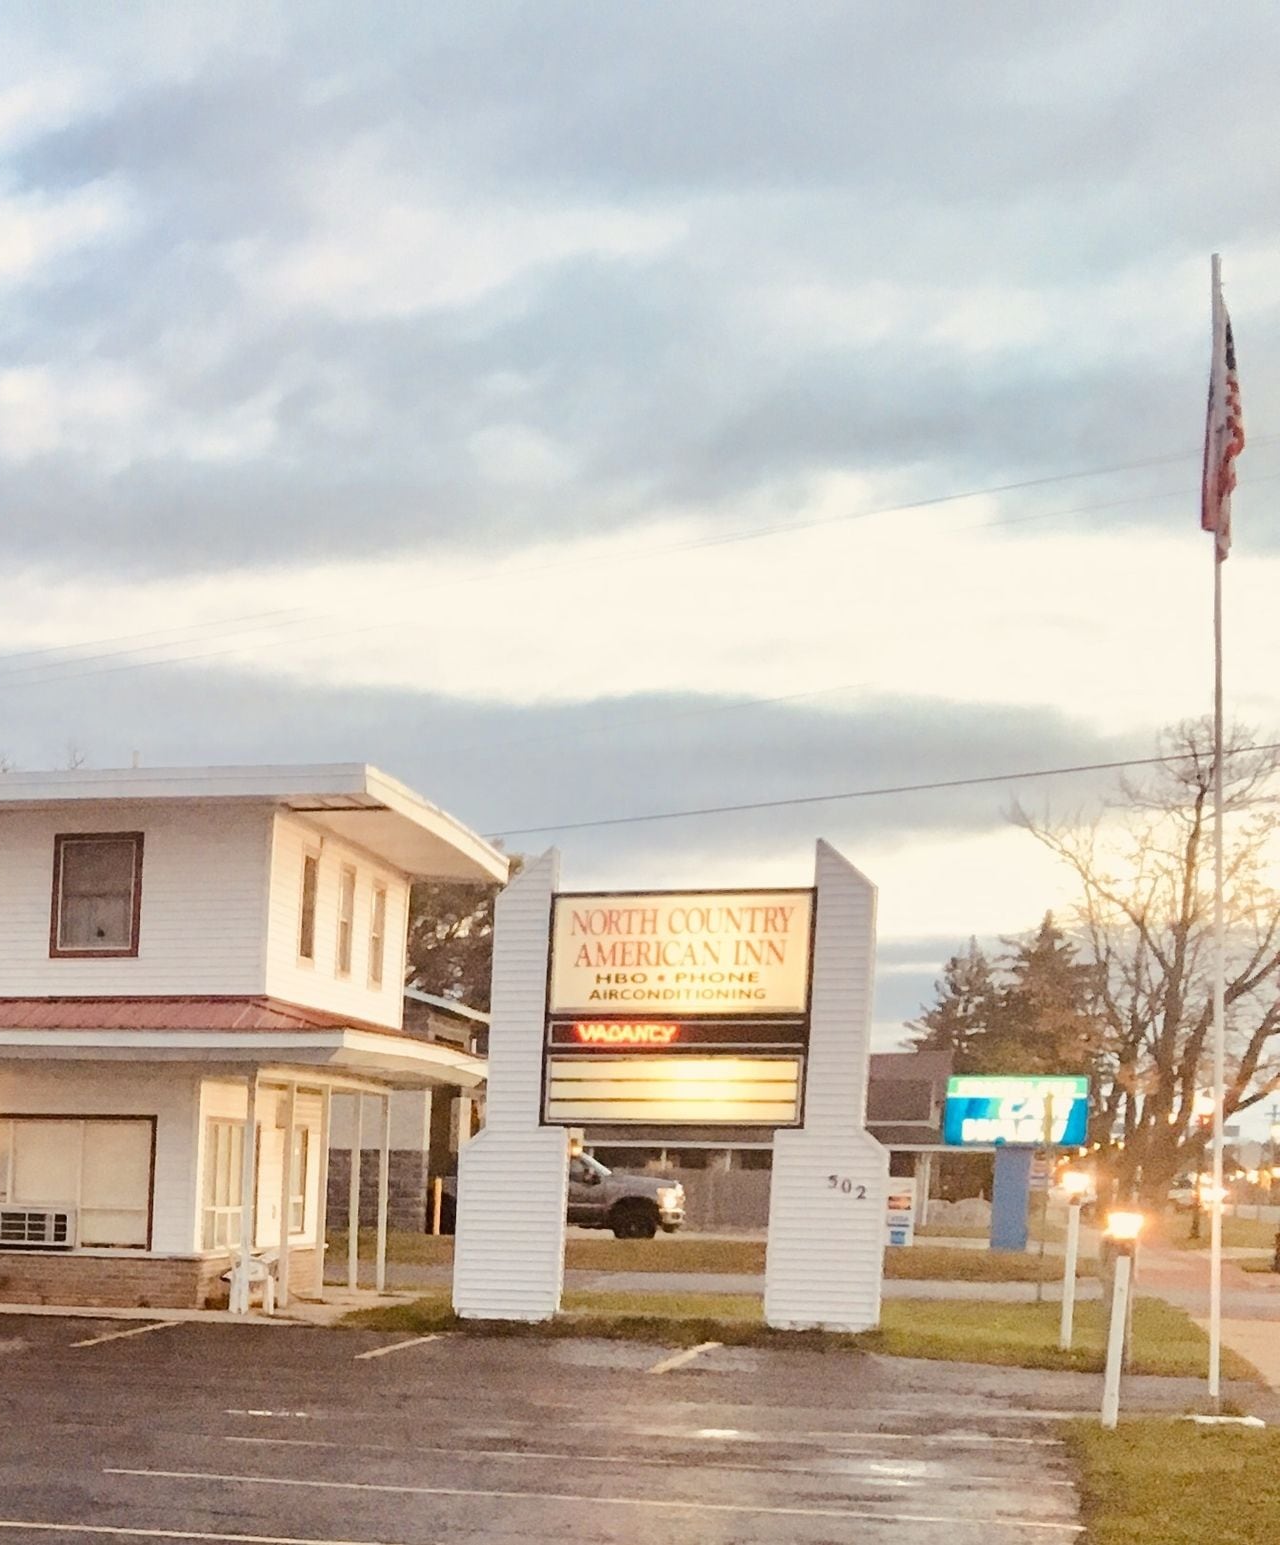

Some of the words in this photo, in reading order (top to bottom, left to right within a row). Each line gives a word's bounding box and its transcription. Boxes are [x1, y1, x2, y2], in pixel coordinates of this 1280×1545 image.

[570, 909, 659, 936] NORTH
[668, 906, 795, 934] COUNTRY
[574, 940, 721, 968] AMERICAN
[734, 939, 787, 966] INN
[595, 972, 648, 984] HBO
[675, 971, 760, 983] PHONE
[589, 988, 767, 1000] AIRCONDITIONING
[578, 1023, 677, 1043] VACANCY
[827, 1174, 867, 1200] 502
